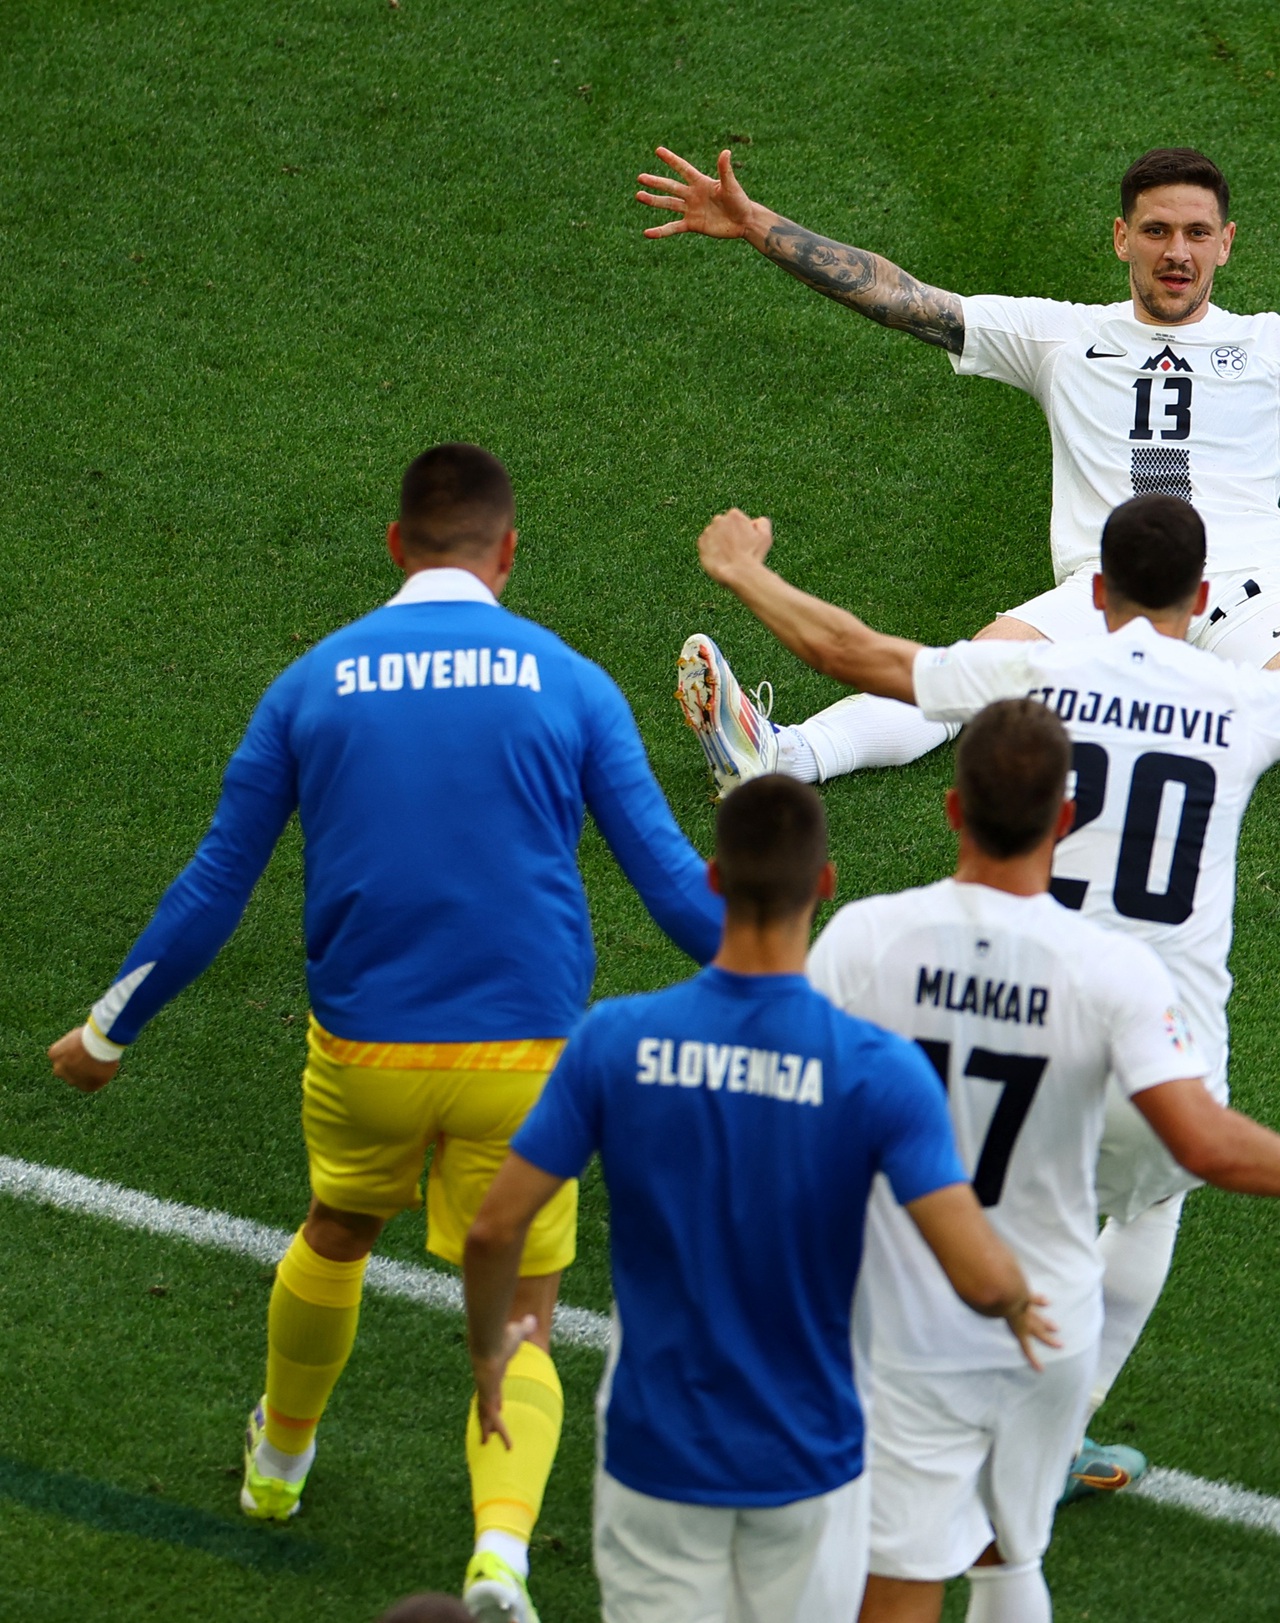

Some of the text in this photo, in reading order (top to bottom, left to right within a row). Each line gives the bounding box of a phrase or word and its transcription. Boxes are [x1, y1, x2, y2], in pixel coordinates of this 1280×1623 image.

[1128, 377, 1194, 440] 13
[334, 648, 542, 696] SLOVENIJA
[915, 966, 1049, 1027] MLAKAR
[636, 1038, 823, 1106] SLOVENIJA
